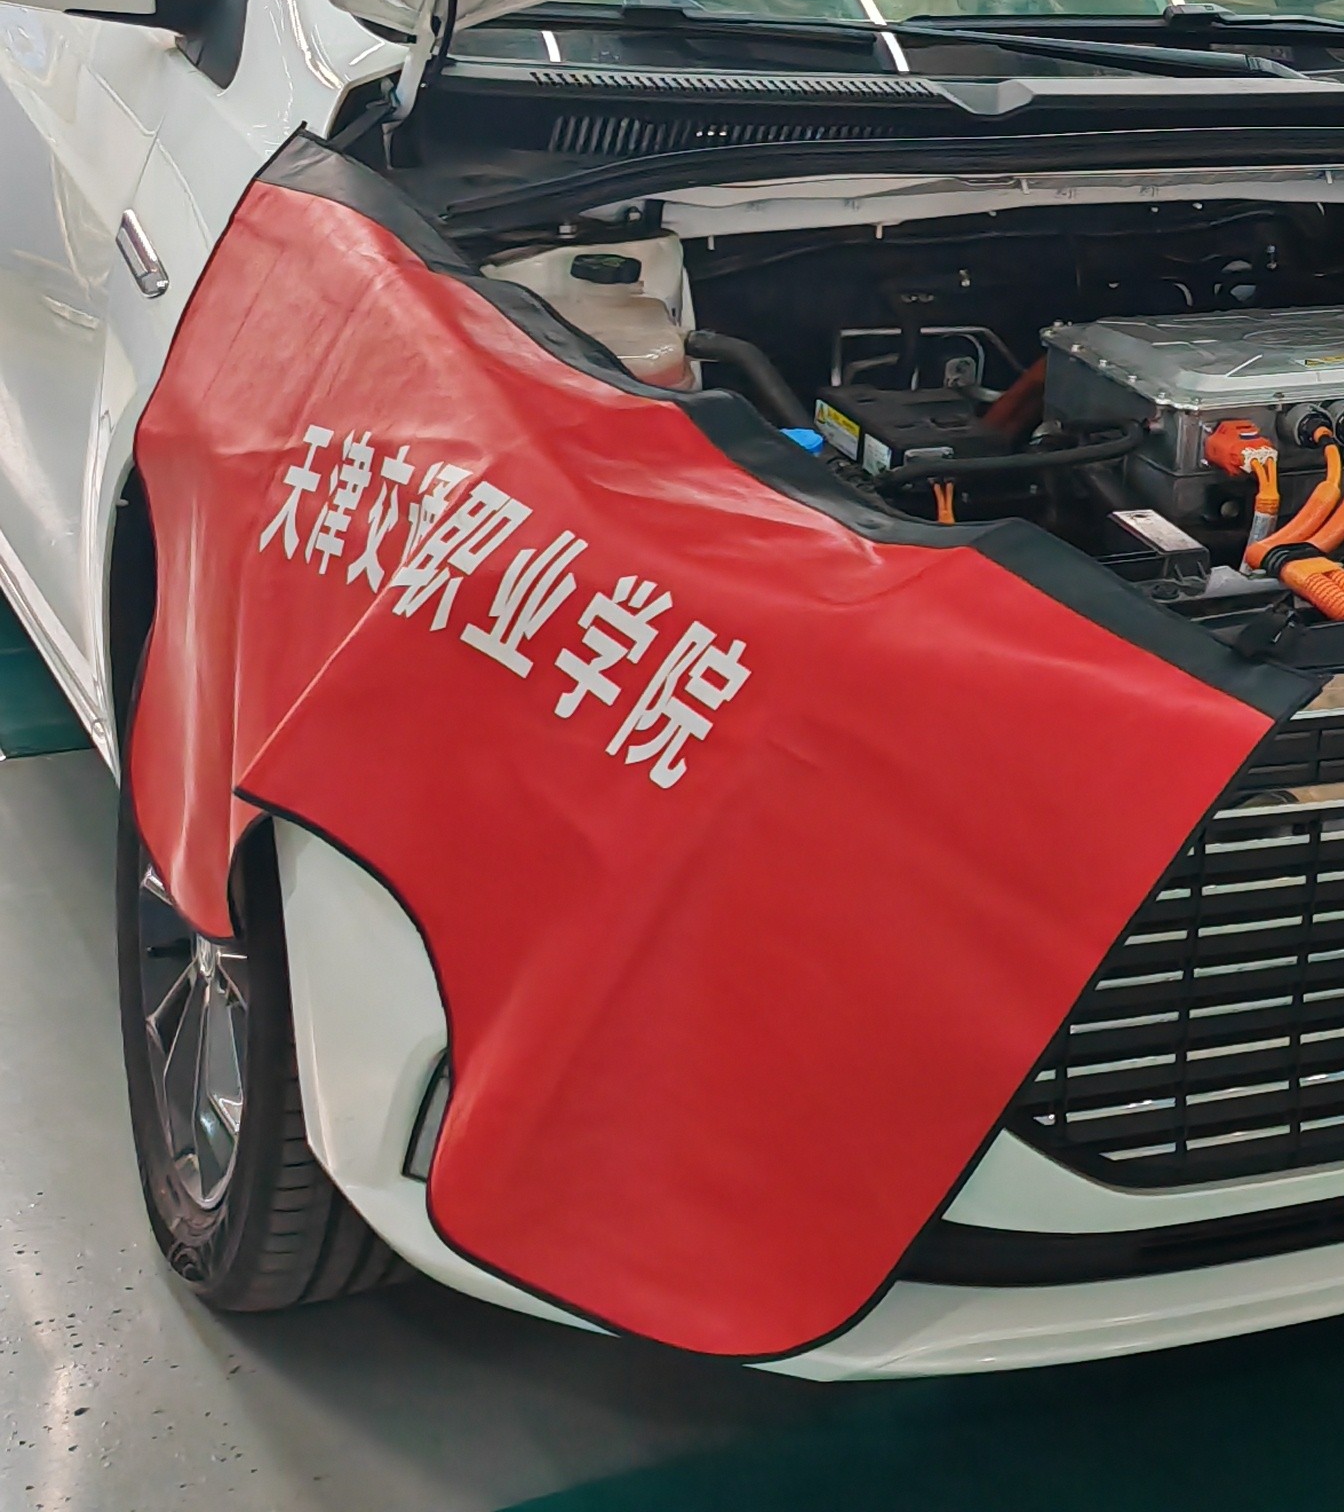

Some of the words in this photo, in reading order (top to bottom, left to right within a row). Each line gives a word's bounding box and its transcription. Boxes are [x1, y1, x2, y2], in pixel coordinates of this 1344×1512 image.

[259, 424, 752, 789] 天津交通职业学院
